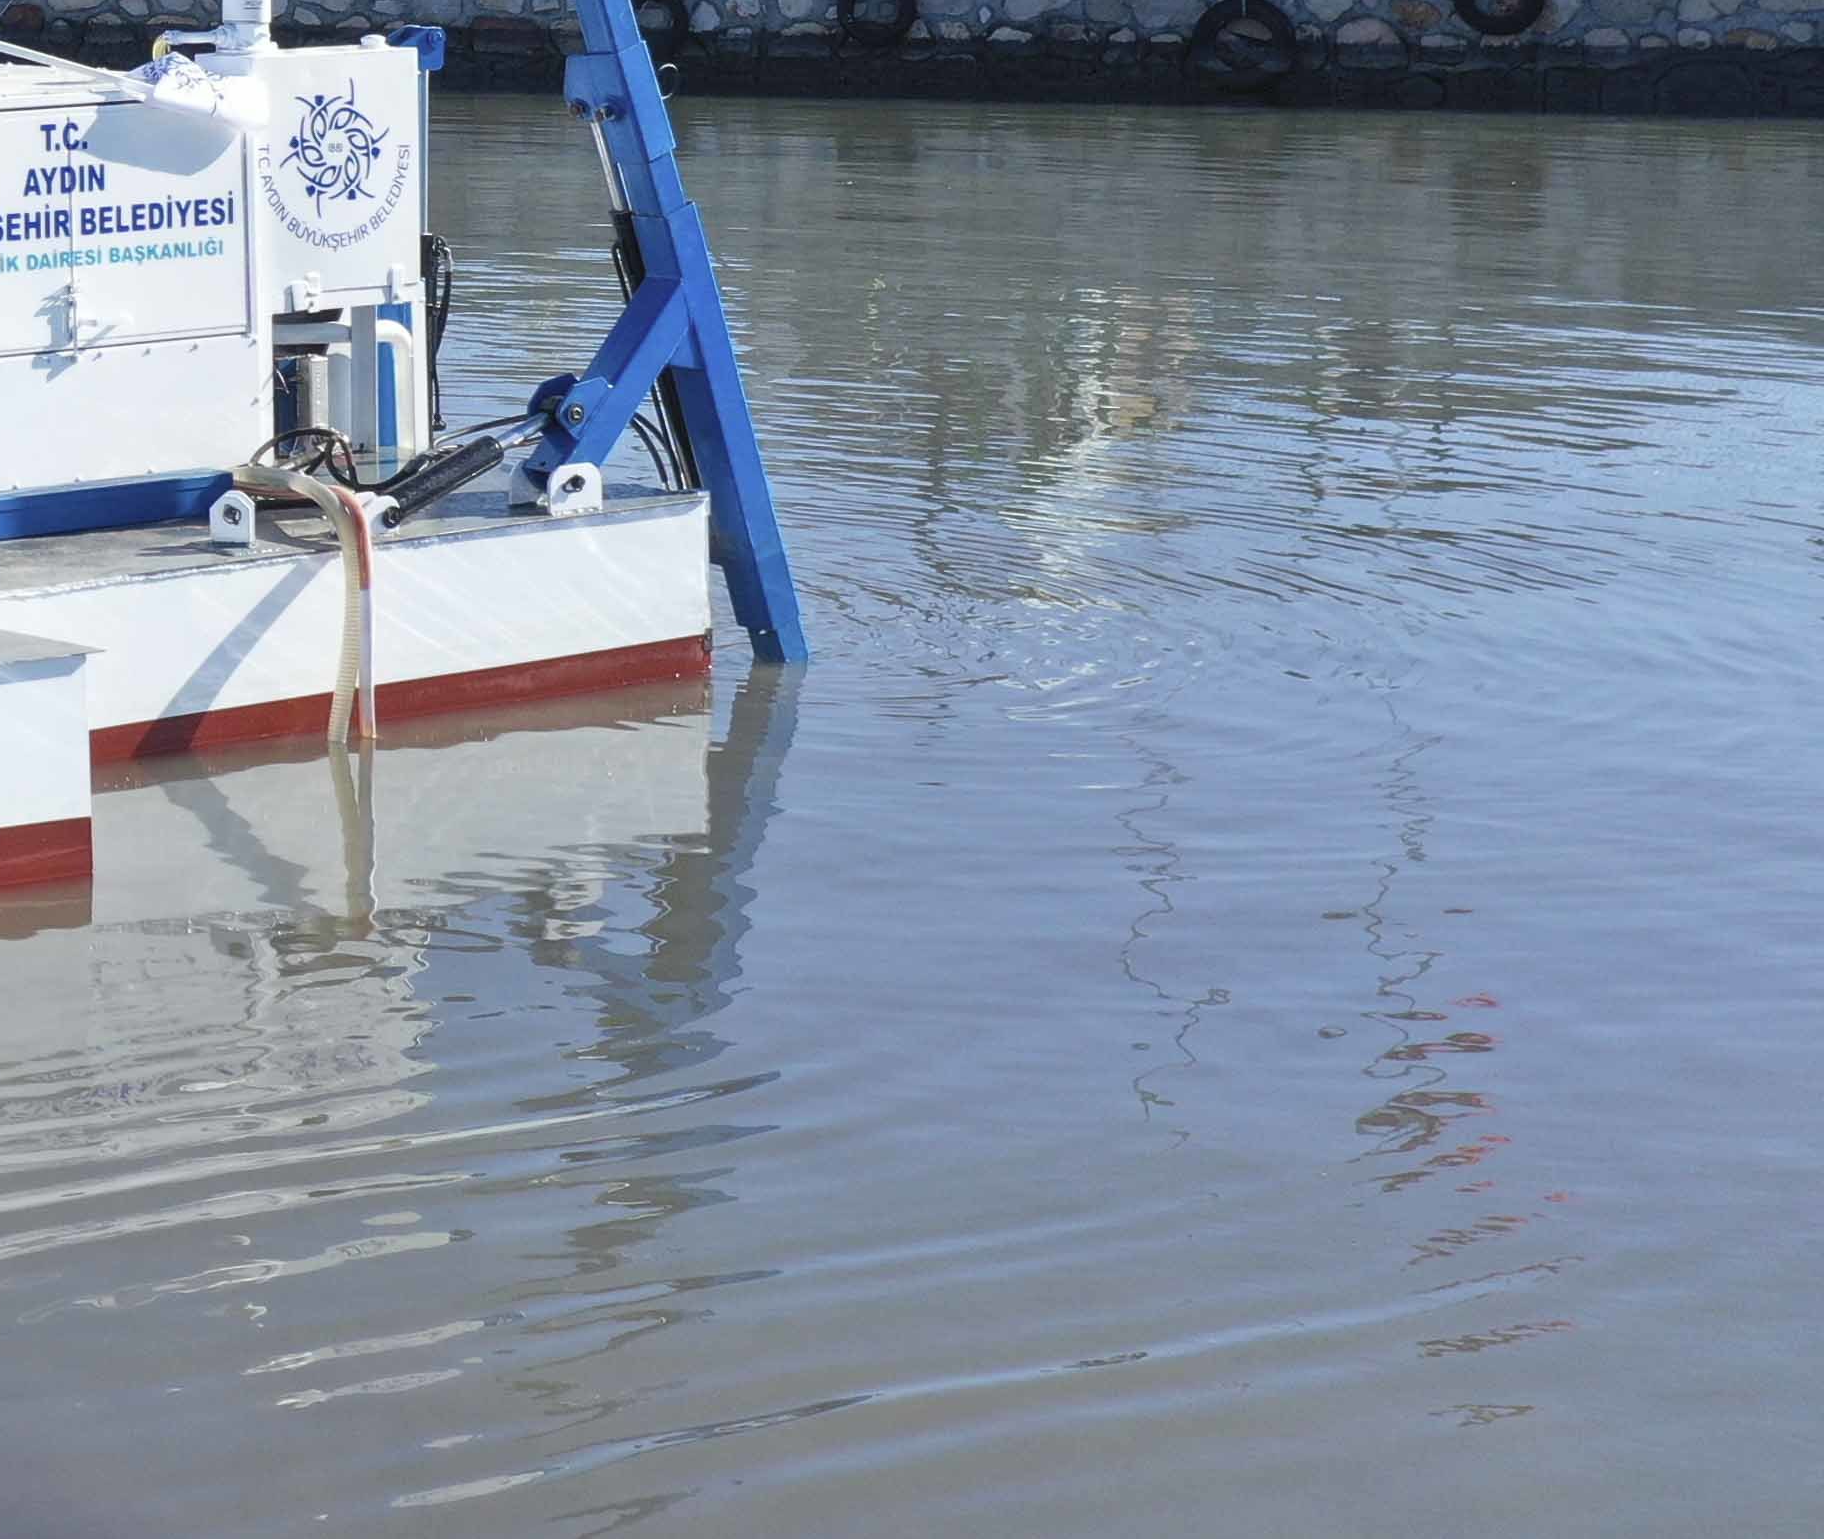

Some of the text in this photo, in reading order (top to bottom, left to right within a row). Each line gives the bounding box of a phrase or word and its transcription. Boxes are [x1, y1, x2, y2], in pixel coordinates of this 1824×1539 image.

[40, 122, 88, 152] T.C.
[23, 164, 105, 197] AYDIN
[80, 191, 235, 237] BELEDİYESİ
[260, 174, 289, 223] AYDIN
[286, 217, 370, 253] BÜYÜKŞEHİR
[27, 244, 103, 272] DAİRESİ
[109, 236, 224, 265] BAŞKANLIĞI
